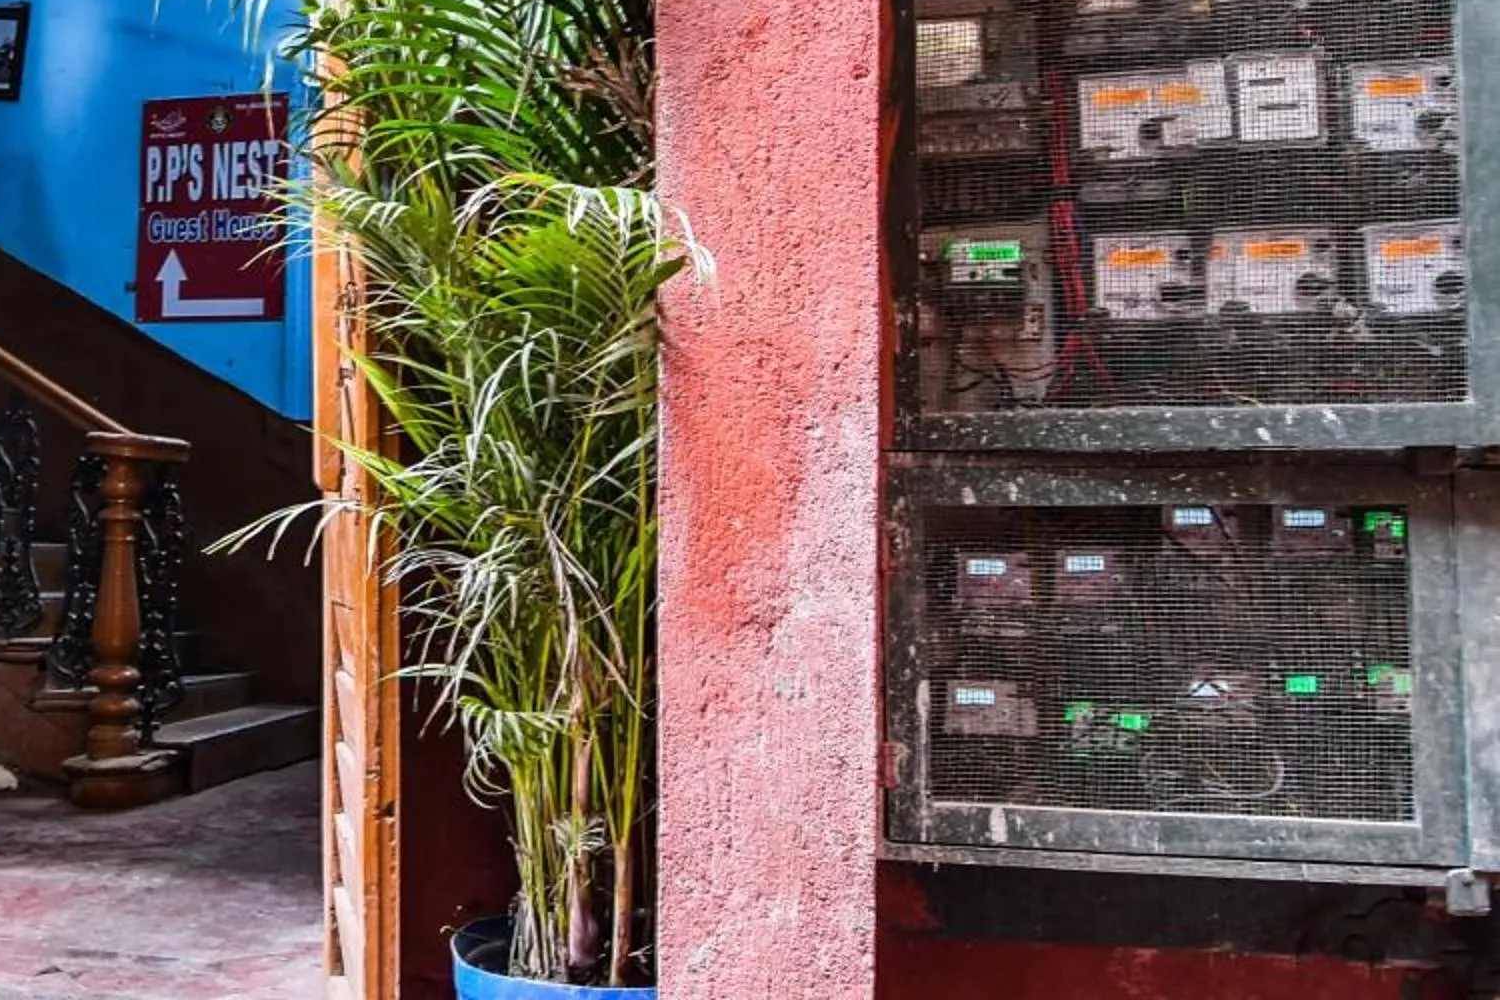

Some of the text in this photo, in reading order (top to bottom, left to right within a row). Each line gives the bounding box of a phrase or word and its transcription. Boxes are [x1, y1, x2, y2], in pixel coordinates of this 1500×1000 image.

[146, 139, 280, 202] P.P'S NEST
[148, 208, 278, 243] Guest House
